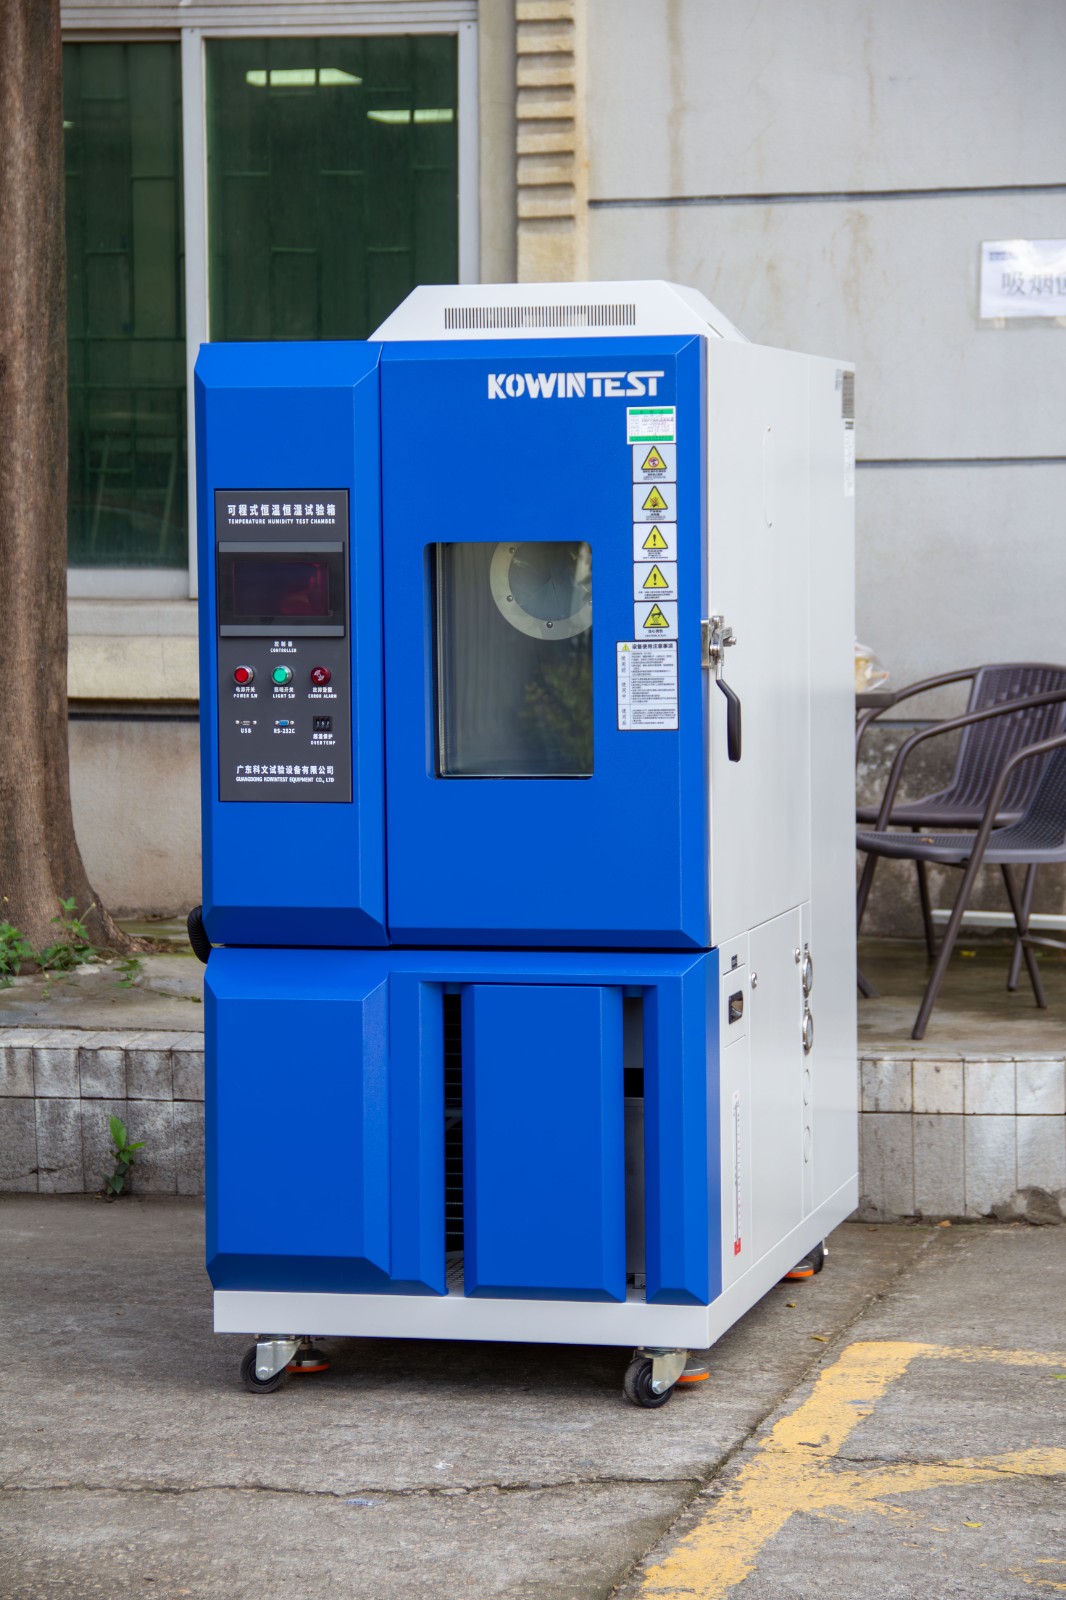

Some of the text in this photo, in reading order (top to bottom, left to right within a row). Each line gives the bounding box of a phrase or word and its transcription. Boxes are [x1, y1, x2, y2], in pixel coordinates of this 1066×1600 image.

[488, 371, 664, 399] KOWINTEST
[228, 504, 336, 516] 可程式恒温恒湿试验箱
[236, 765, 334, 775] 广东科文试验设备有限公司
